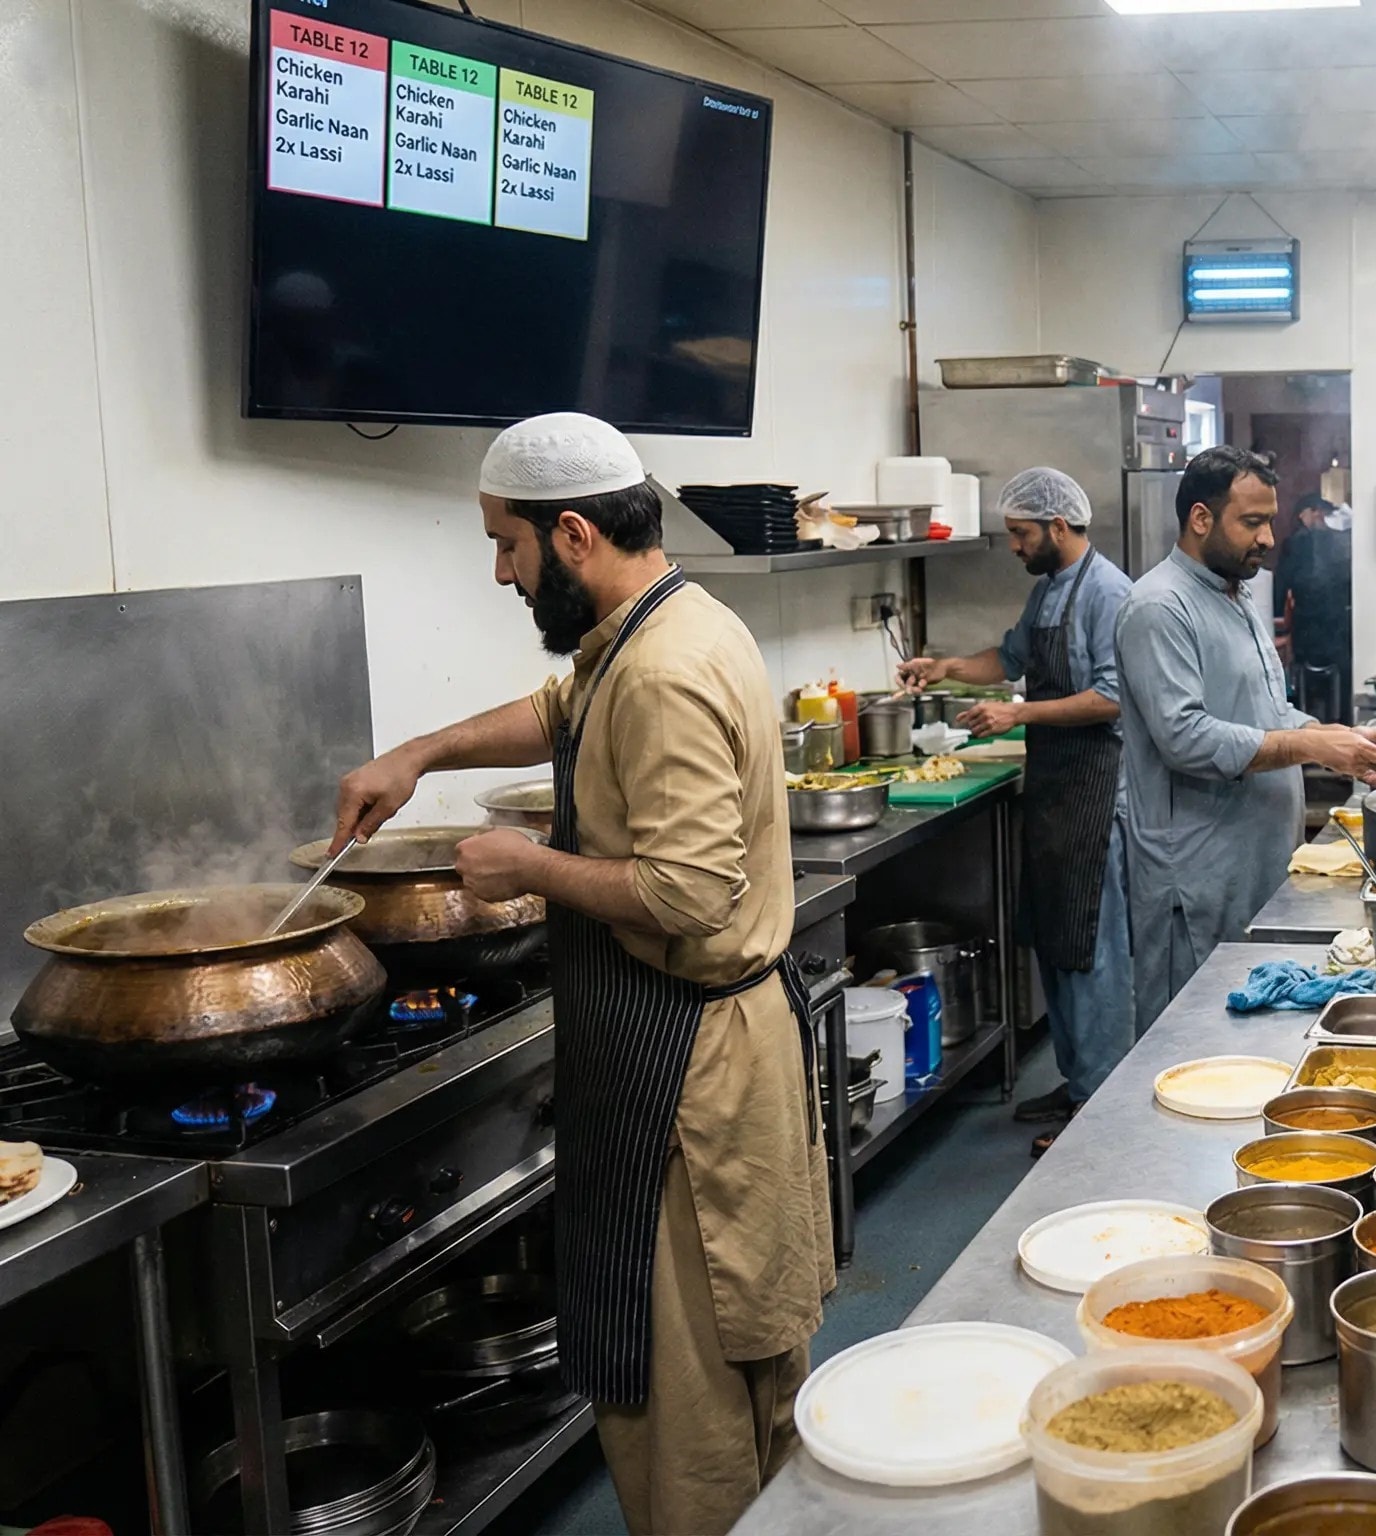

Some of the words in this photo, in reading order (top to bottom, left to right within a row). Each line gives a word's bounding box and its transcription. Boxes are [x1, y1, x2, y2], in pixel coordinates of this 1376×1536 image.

[290, 25, 344, 53] TABLE
[349, 41, 369, 59] 12
[276, 56, 343, 86] Chicken
[409, 54, 457, 80] TABLE
[461, 68, 479, 86] 12
[276, 79, 330, 105] Karahi
[396, 84, 455, 110] Chicken
[515, 80, 559, 105] TABLE
[562, 93, 578, 110] 12
[276, 108, 324, 132] Garlic
[328, 118, 369, 141] Naan
[396, 105, 443, 129] Karahi
[503, 108, 556, 133] Chicken
[275, 136, 296, 155] 2x
[300, 140, 342, 163] Lassi
[395, 132, 438, 155] Garlic
[441, 141, 477, 162] Naan
[503, 128, 546, 151] Karahi
[394, 159, 413, 176] 2x
[416, 163, 454, 184] Lassi
[502, 154, 541, 175] Garlic
[543, 161, 577, 182] Naan
[501, 179, 518, 196] 2x
[520, 182, 555, 202] Lassi
